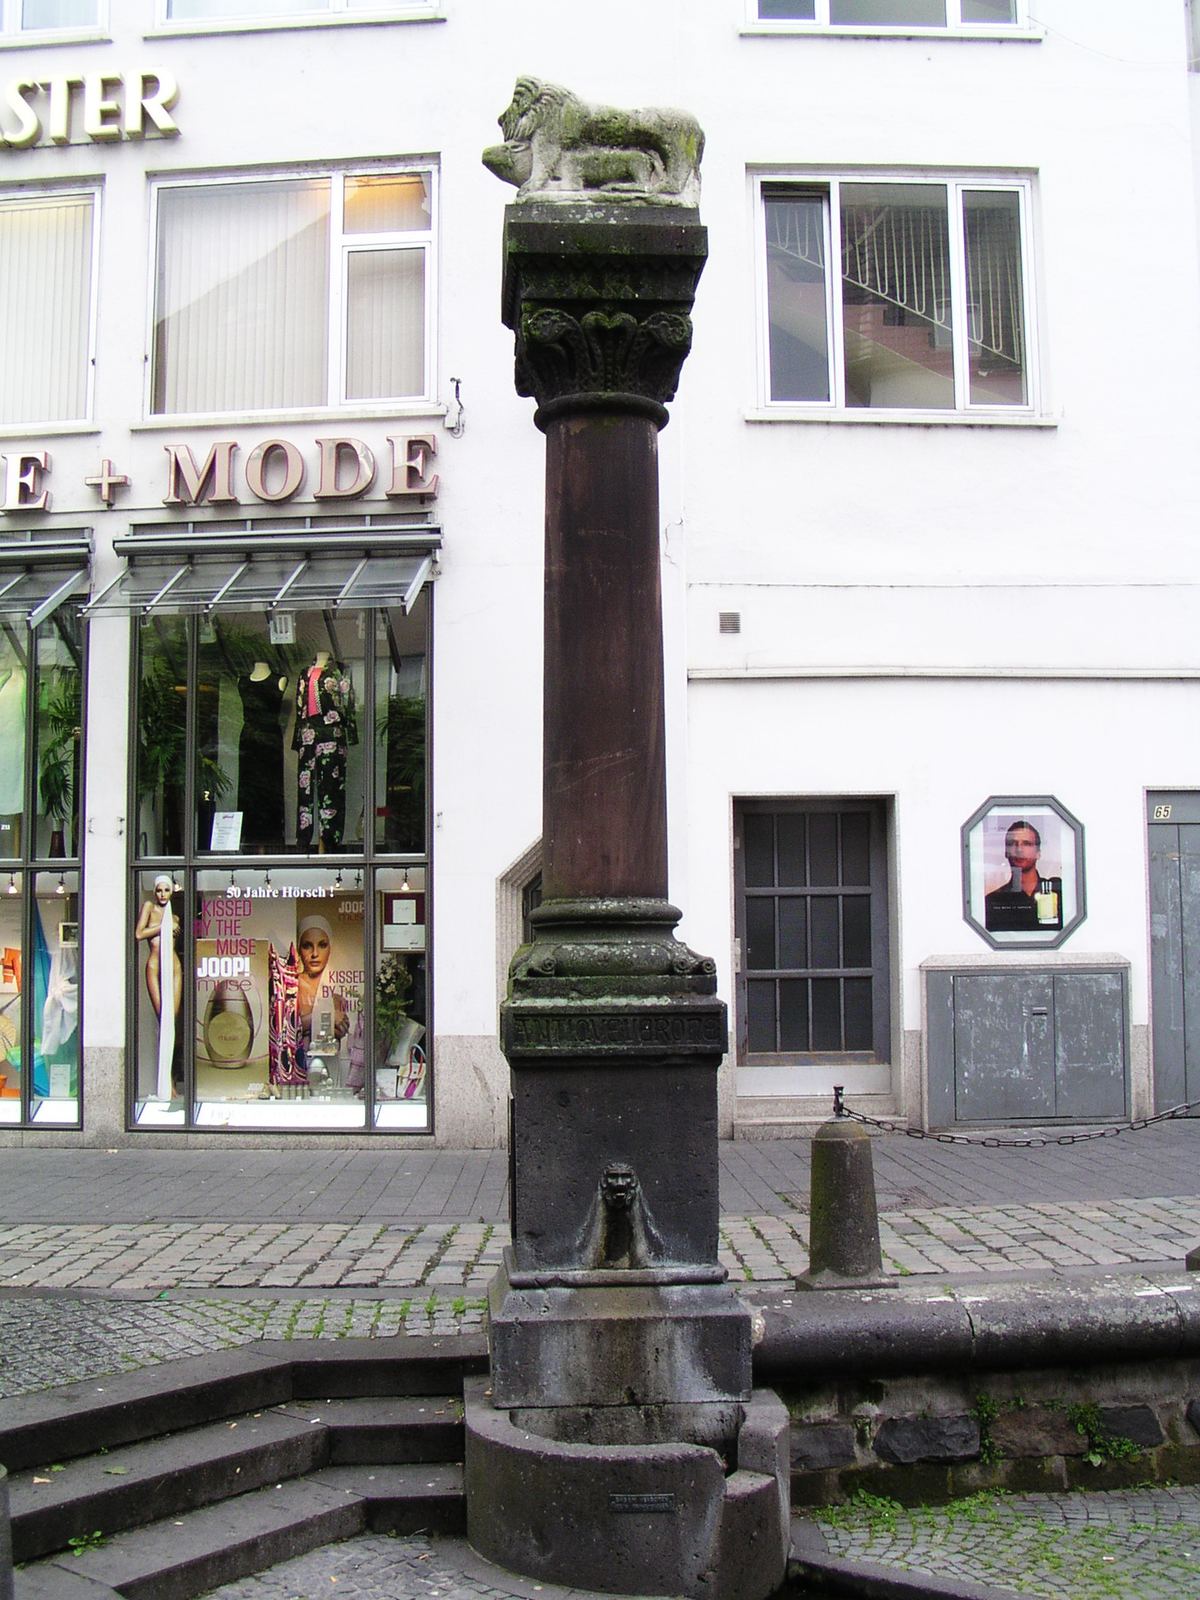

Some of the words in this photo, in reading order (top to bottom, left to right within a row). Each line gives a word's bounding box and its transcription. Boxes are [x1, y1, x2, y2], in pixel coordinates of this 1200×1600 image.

[0, 70, 181, 148] STER
[162, 434, 440, 506] MODE
[1155, 806, 1170, 818] 65
[226, 887, 241, 899] 50
[243, 886, 280, 899] Jahre
[282, 886, 326, 898] Hörsch
[202, 900, 252, 917] KISSED
[215, 919, 241, 936] THE
[216, 939, 256, 956] MUSE
[197, 957, 251, 978] JOOP!
[197, 979, 252, 992] muse
[328, 970, 365, 984] KISSED
[322, 986, 335, 999] BY
[338, 984, 359, 998] THE
